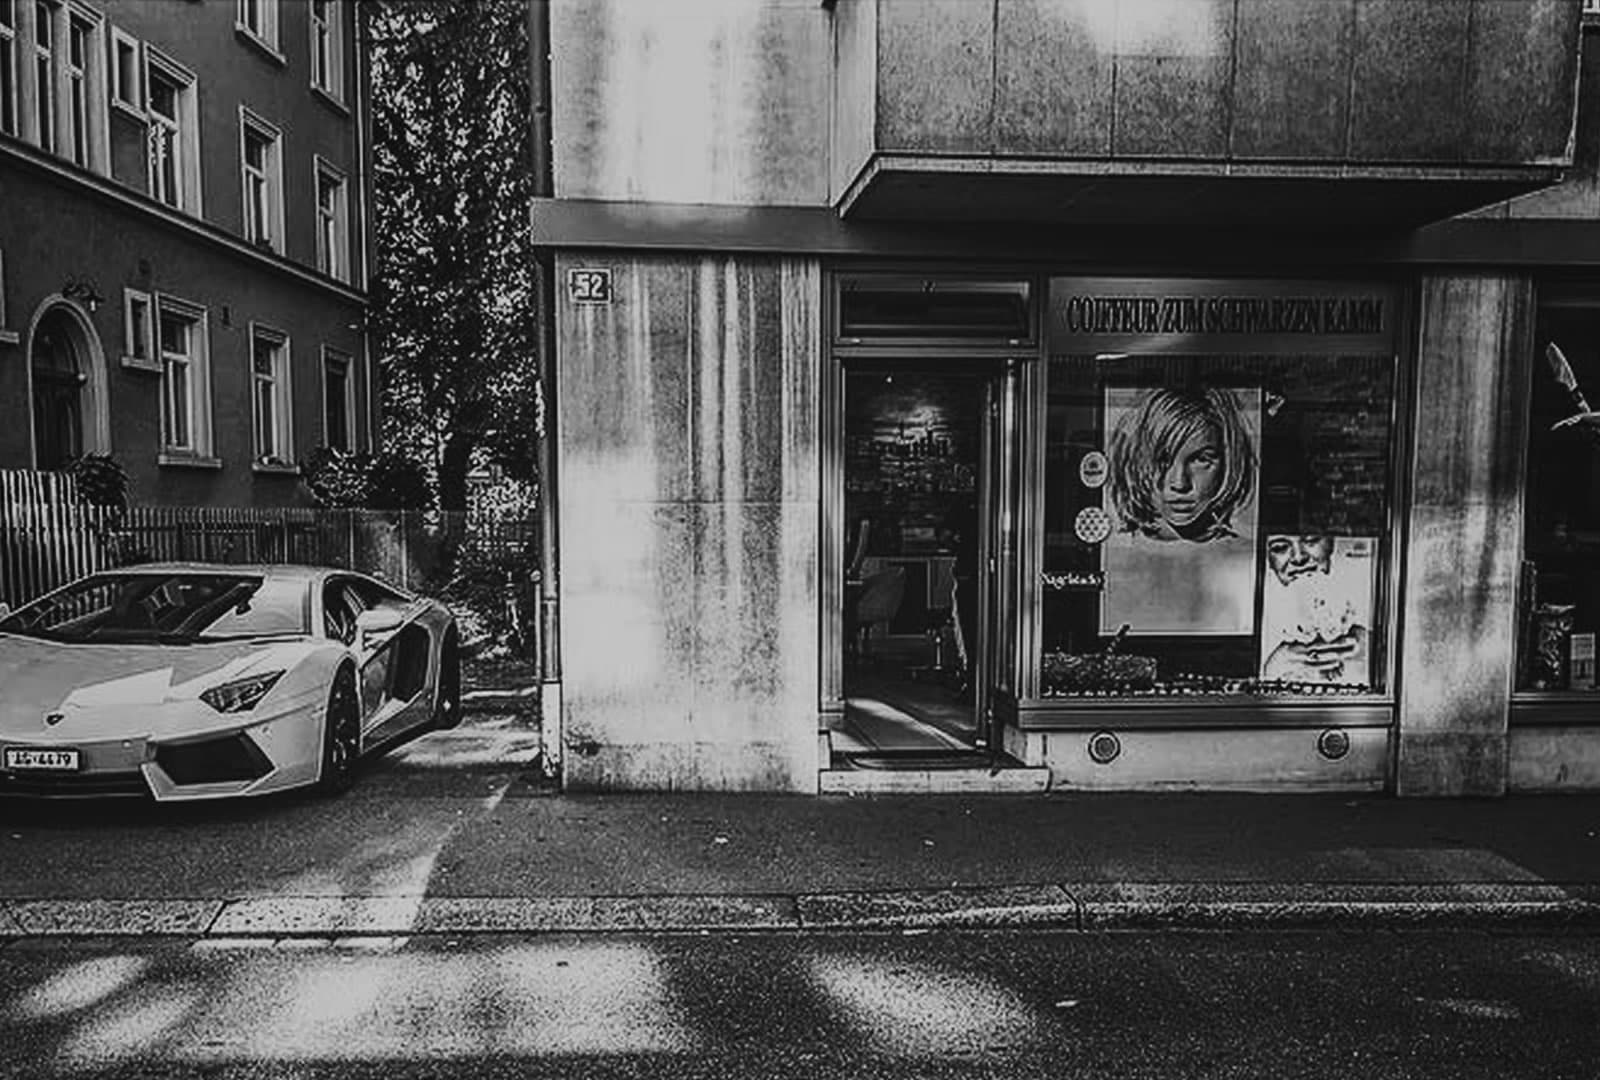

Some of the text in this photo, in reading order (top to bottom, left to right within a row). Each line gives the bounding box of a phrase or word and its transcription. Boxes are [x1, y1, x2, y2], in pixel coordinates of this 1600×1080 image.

[573, 272, 604, 299] 52
[1068, 297, 1384, 334] COIFFEUR ZUM SCHWARZEN KAMM
